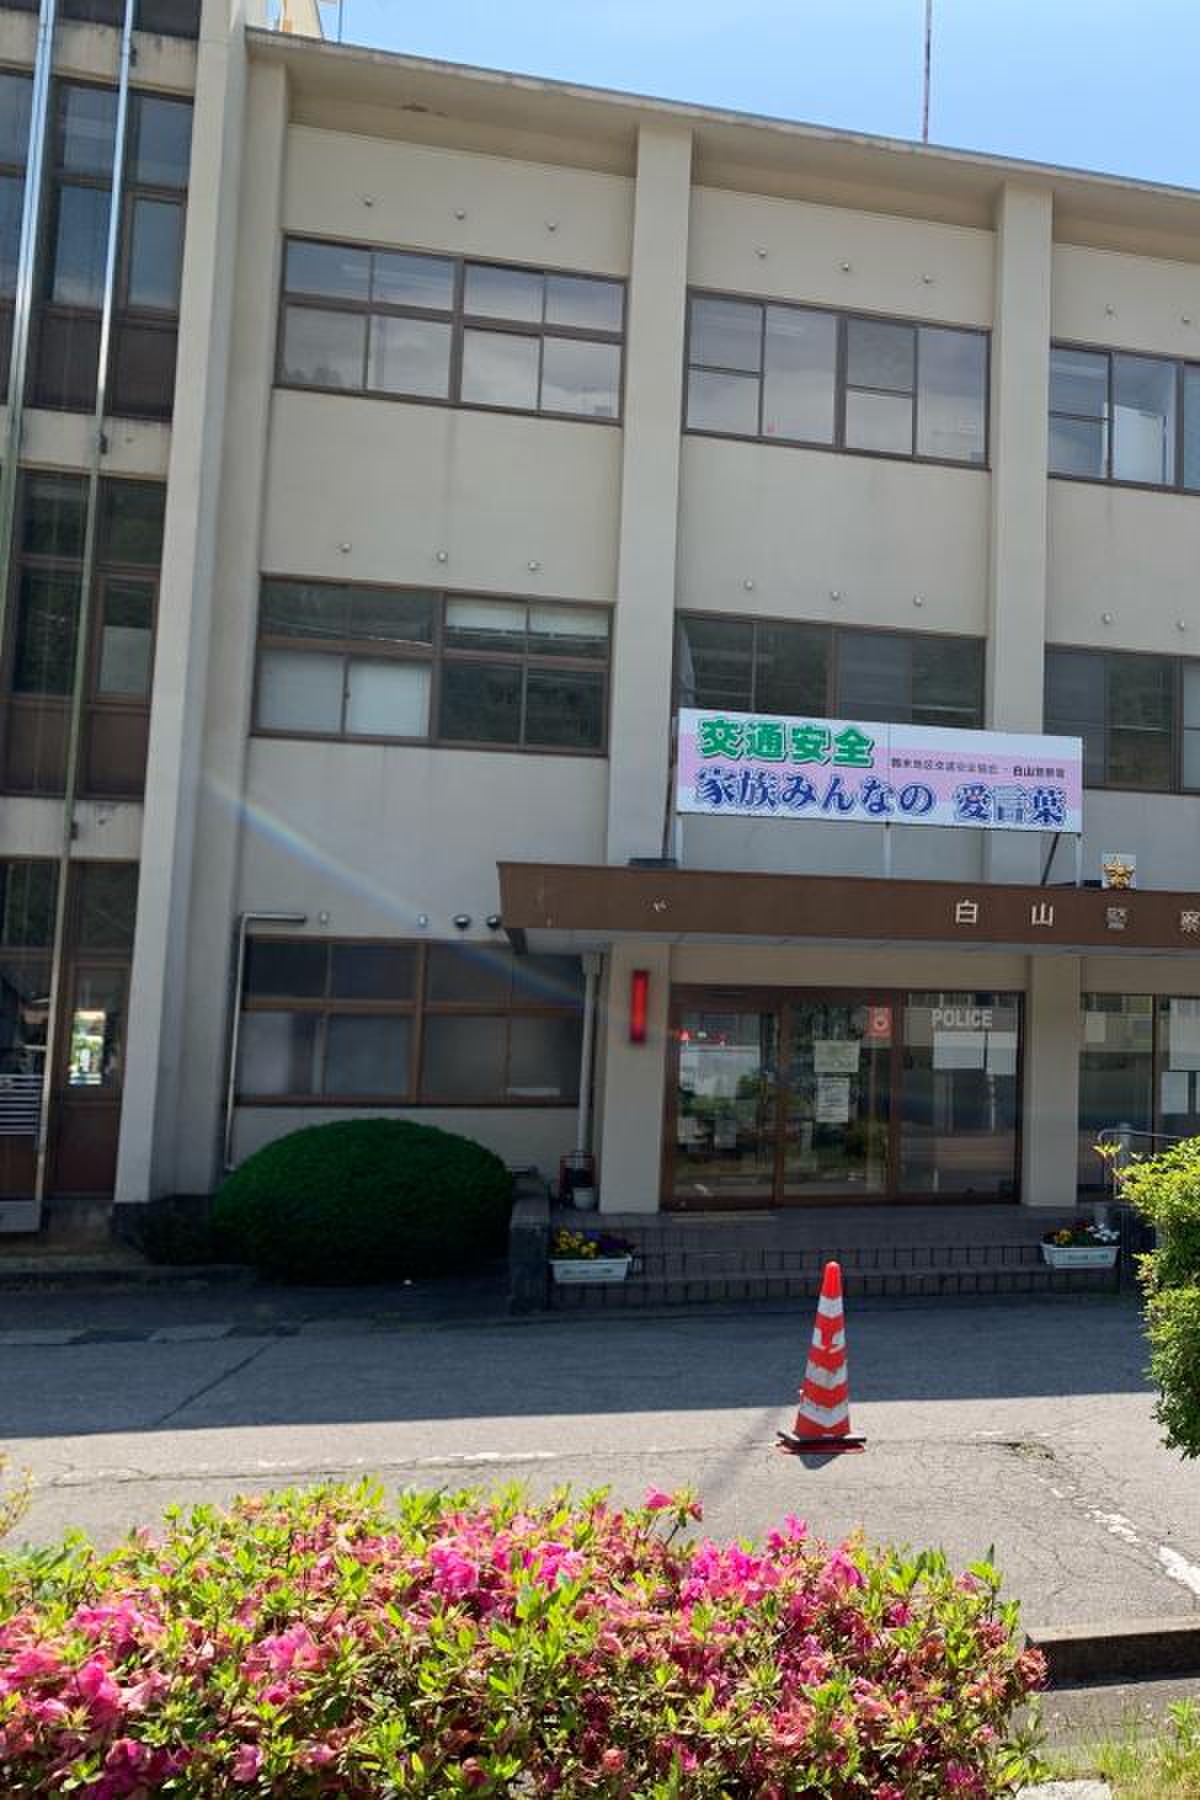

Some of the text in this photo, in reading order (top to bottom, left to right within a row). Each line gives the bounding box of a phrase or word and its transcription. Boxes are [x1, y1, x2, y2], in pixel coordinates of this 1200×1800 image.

[700, 719, 874, 768] 交通安全
[698, 768, 1067, 823] 家族みんなの 愛言葉
[931, 1009, 992, 1027] POLICE
